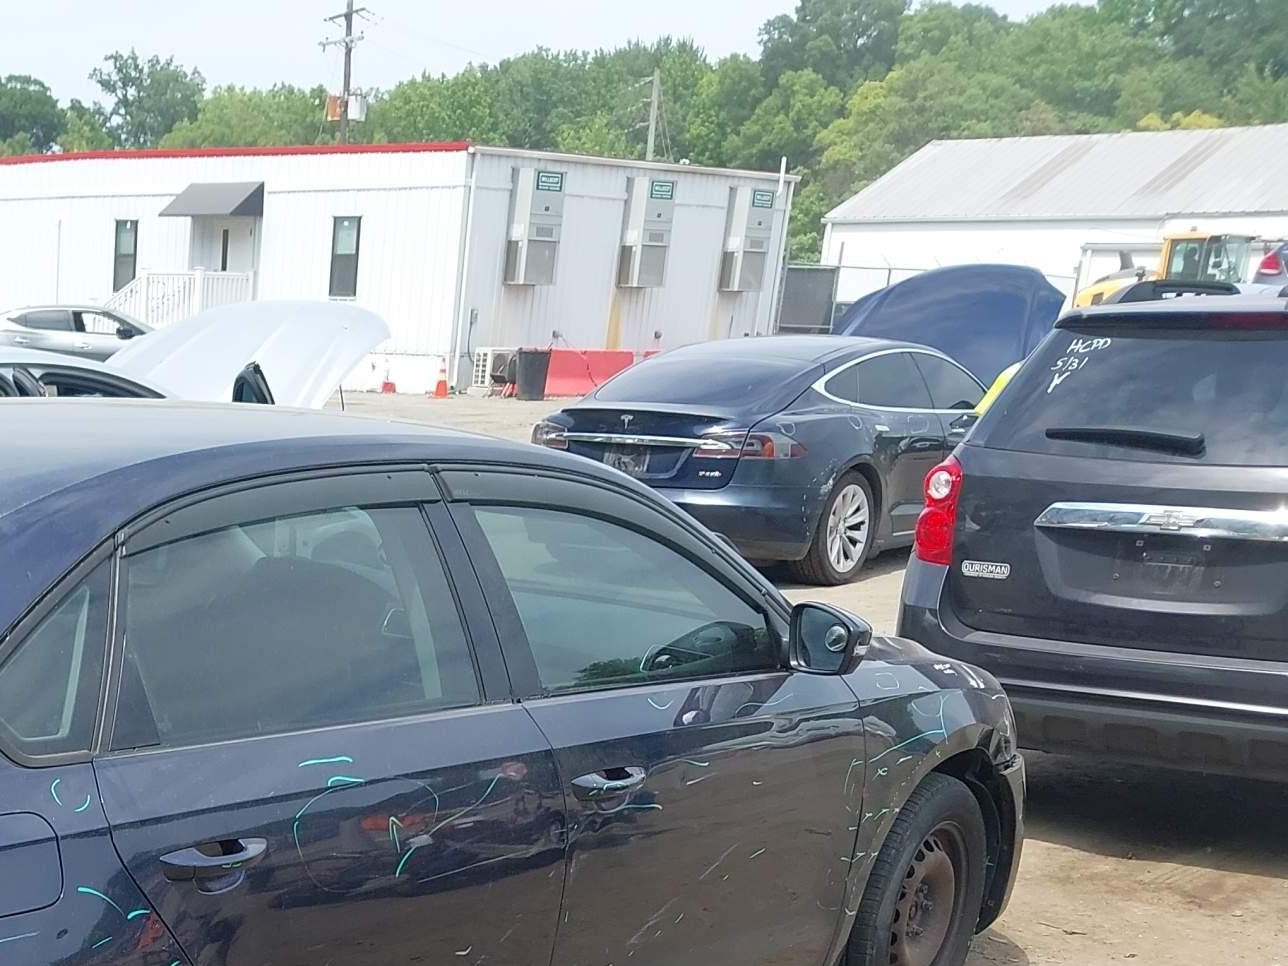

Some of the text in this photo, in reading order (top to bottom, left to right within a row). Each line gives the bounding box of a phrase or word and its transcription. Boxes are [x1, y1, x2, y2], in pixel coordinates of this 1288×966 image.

[1065, 337, 1112, 354] HCPD
[1050, 356, 1089, 371] 5/31
[964, 562, 1008, 575] OURISMAN
